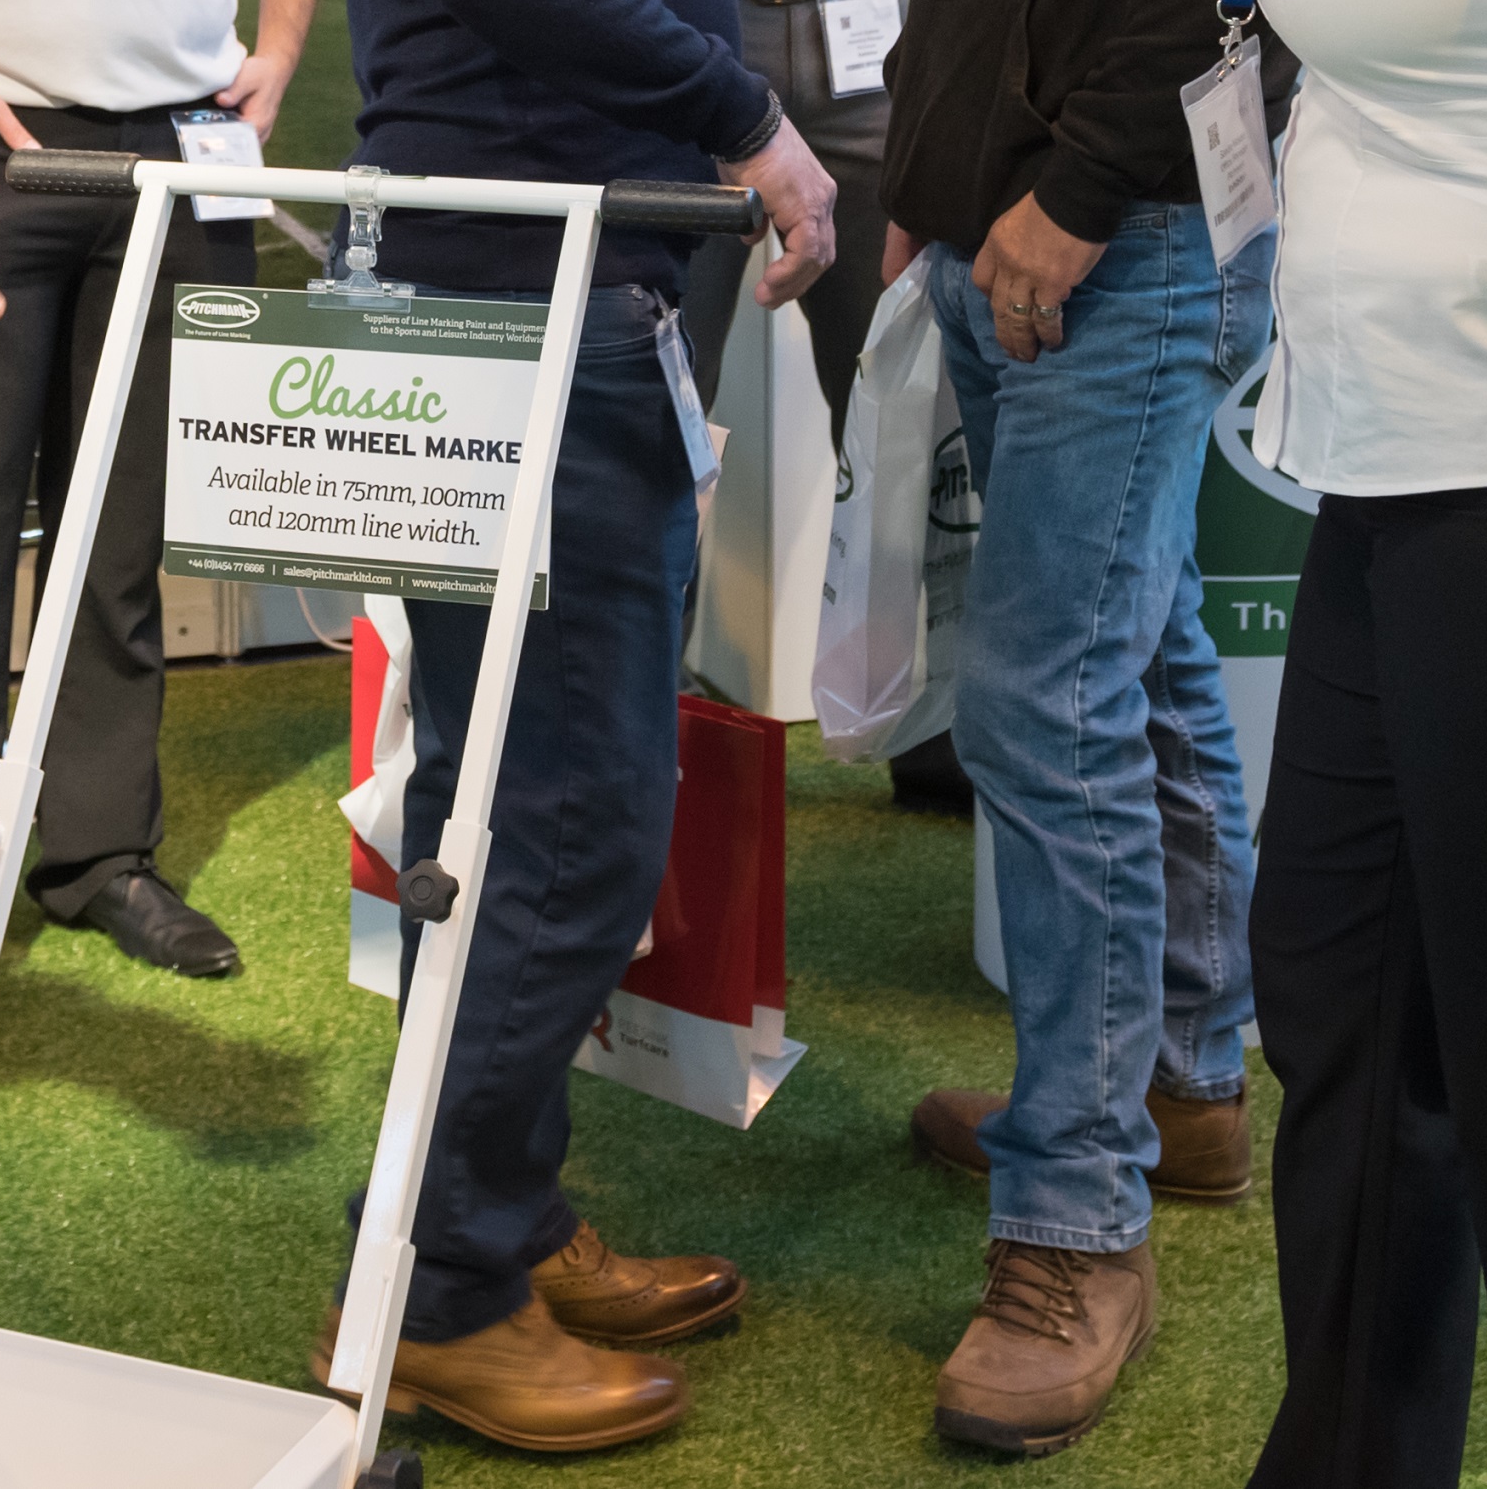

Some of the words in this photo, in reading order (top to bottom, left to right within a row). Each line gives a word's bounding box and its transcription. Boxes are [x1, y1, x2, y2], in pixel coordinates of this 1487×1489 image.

[186, 300, 251, 318] PITCHMARK
[363, 314, 400, 324] Suppliers
[401, 315, 411, 325] of
[411, 316, 429, 326] Line
[430, 317, 464, 329] Marking
[465, 319, 486, 329] Paint
[488, 321, 503, 331] and
[505, 322, 546, 333] Equipmen
[230, 331, 251, 340] Marking
[370, 326, 379, 334] to
[380, 326, 393, 335] the
[394, 327, 421, 337] Sports
[422, 328, 437, 338] and
[438, 329, 468, 340] Leisure
[469, 331, 504, 343] Industry
[506, 333, 544, 344] Worldwid
[268, 354, 447, 423] Classic
[178, 418, 316, 451] TRANSFER
[325, 428, 417, 457] WHEEL
[424, 435, 523, 465] MARKE
[208, 466, 312, 496] Available
[316, 475, 339, 498] in
[342, 480, 417, 507] 75mm,
[421, 486, 505, 511] 100mm
[229, 505, 273, 530] and
[276, 509, 356, 537] 120mm
[362, 513, 403, 540] line
[407, 517, 481, 547] width.
[187, 558, 203, 569] +44
[233, 562, 244, 572] 77
[244, 563, 265, 574] 6666
[283, 566, 392, 586] sales@pitchmarkltd.com
[412, 577, 497, 594] www.pitchmarklt
[1231, 601, 1286, 631] Th
